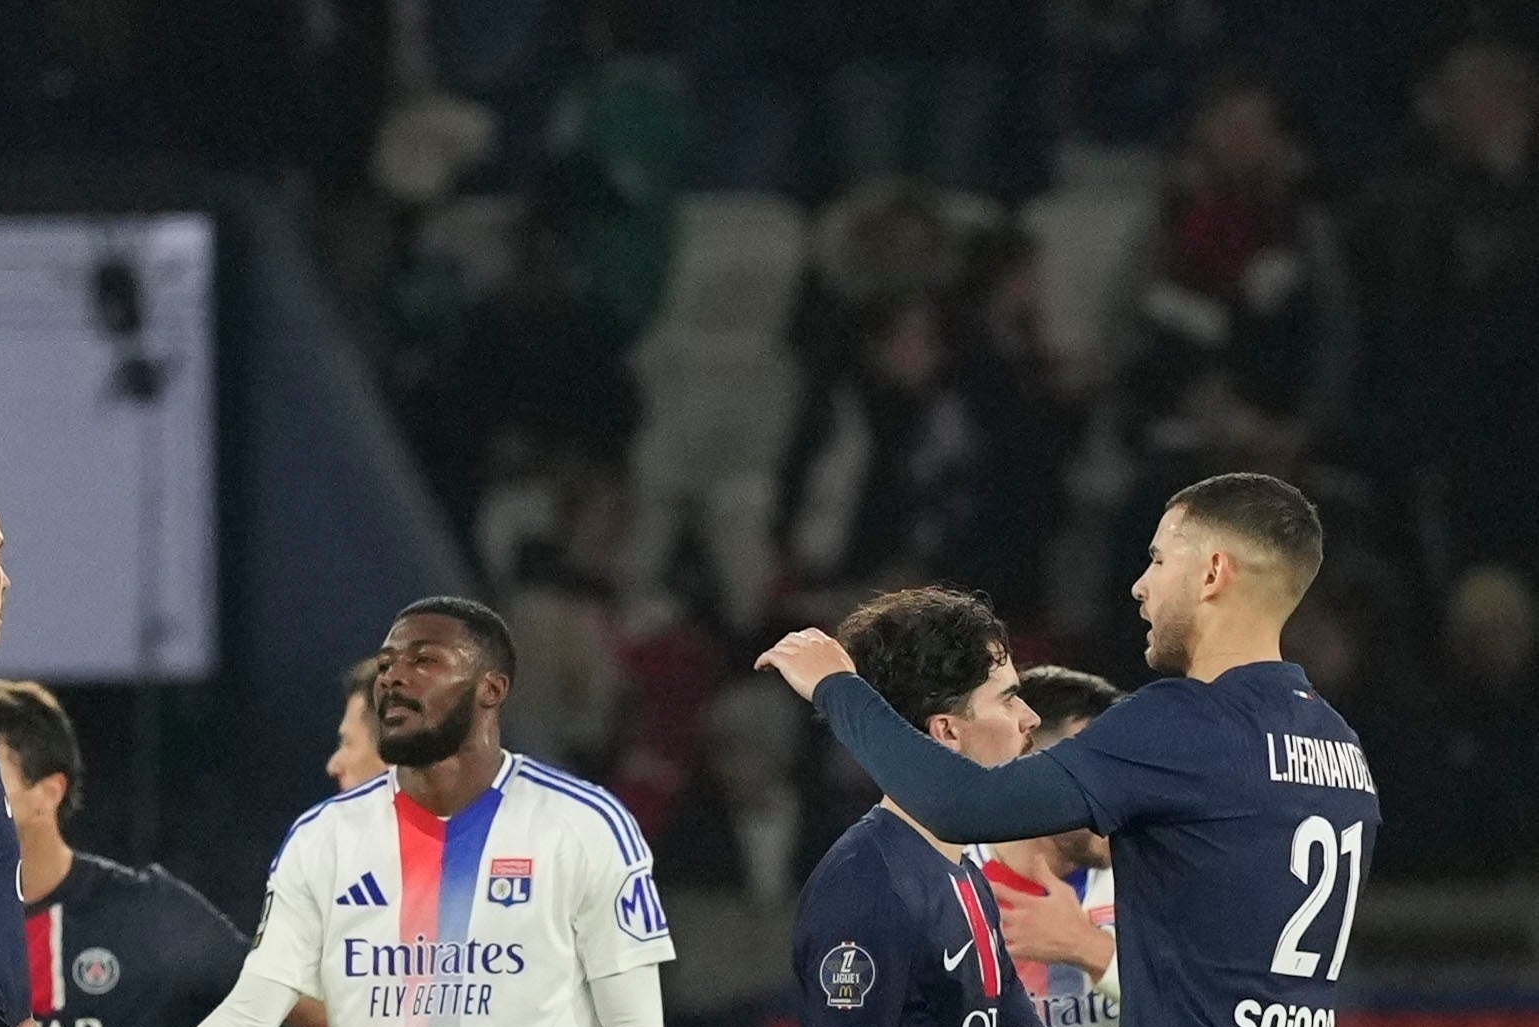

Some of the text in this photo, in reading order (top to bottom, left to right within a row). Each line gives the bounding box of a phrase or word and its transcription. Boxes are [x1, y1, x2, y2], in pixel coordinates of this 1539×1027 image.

[1270, 815, 1363, 982] 21
[344, 935, 525, 977] Emirates
[369, 983, 492, 1018] FLY BETTER
